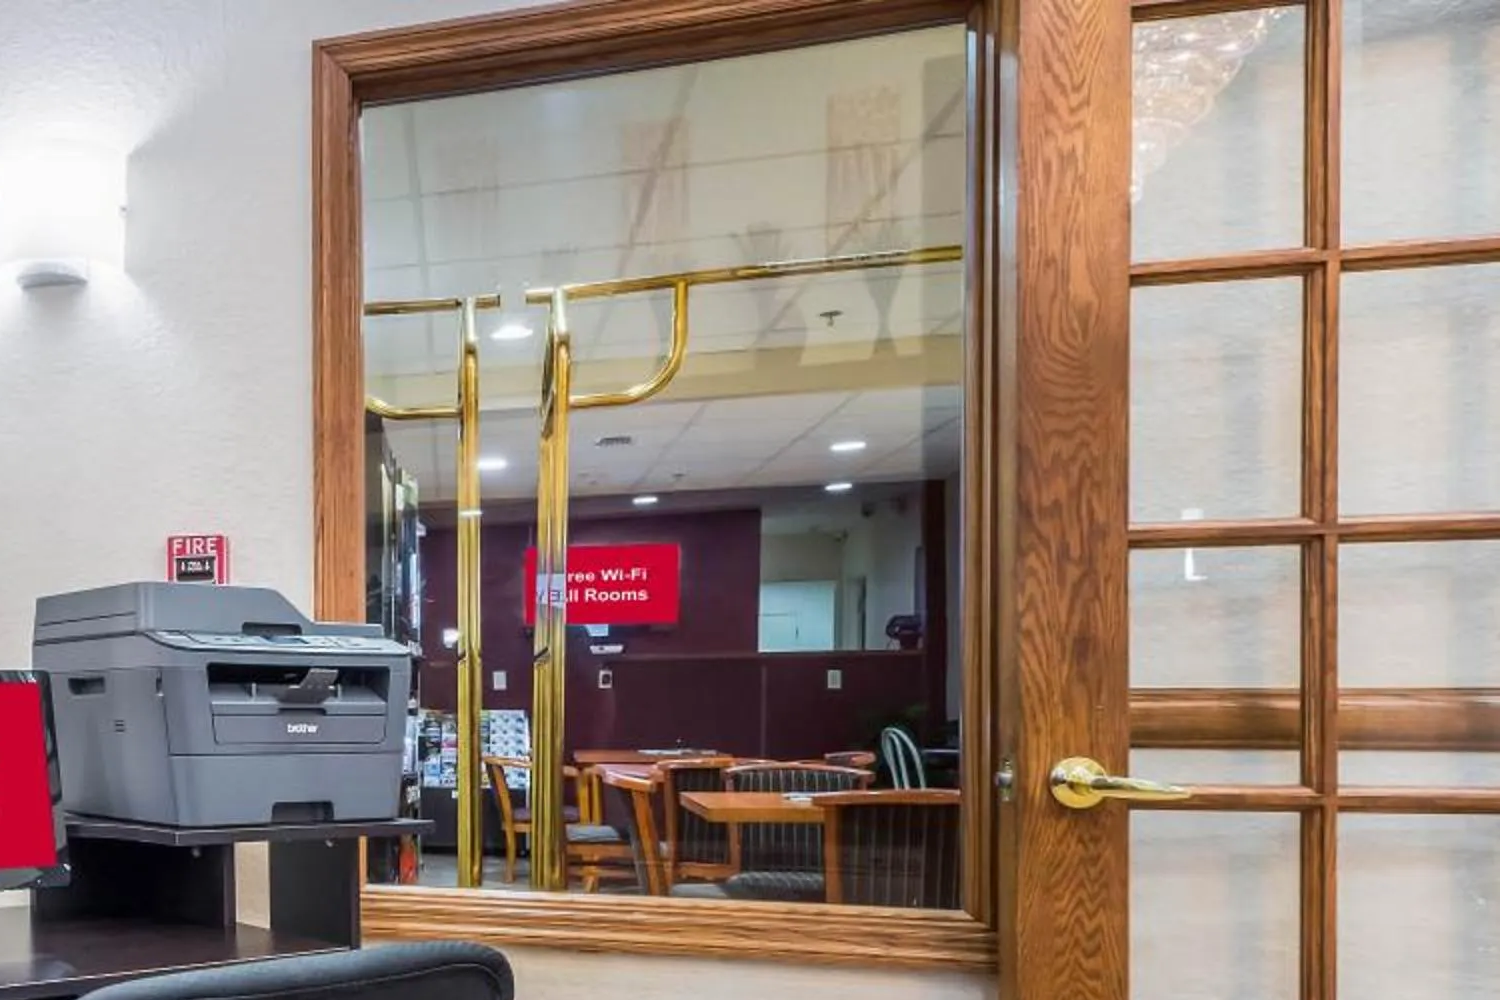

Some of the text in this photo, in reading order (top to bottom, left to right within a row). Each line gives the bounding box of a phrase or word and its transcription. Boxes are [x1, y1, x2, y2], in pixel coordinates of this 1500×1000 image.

[173, 538, 217, 554] FIRE
[567, 568, 647, 583] ree Wi-Fi
[585, 588, 649, 602] Rooms
[287, 723, 318, 733] brother
